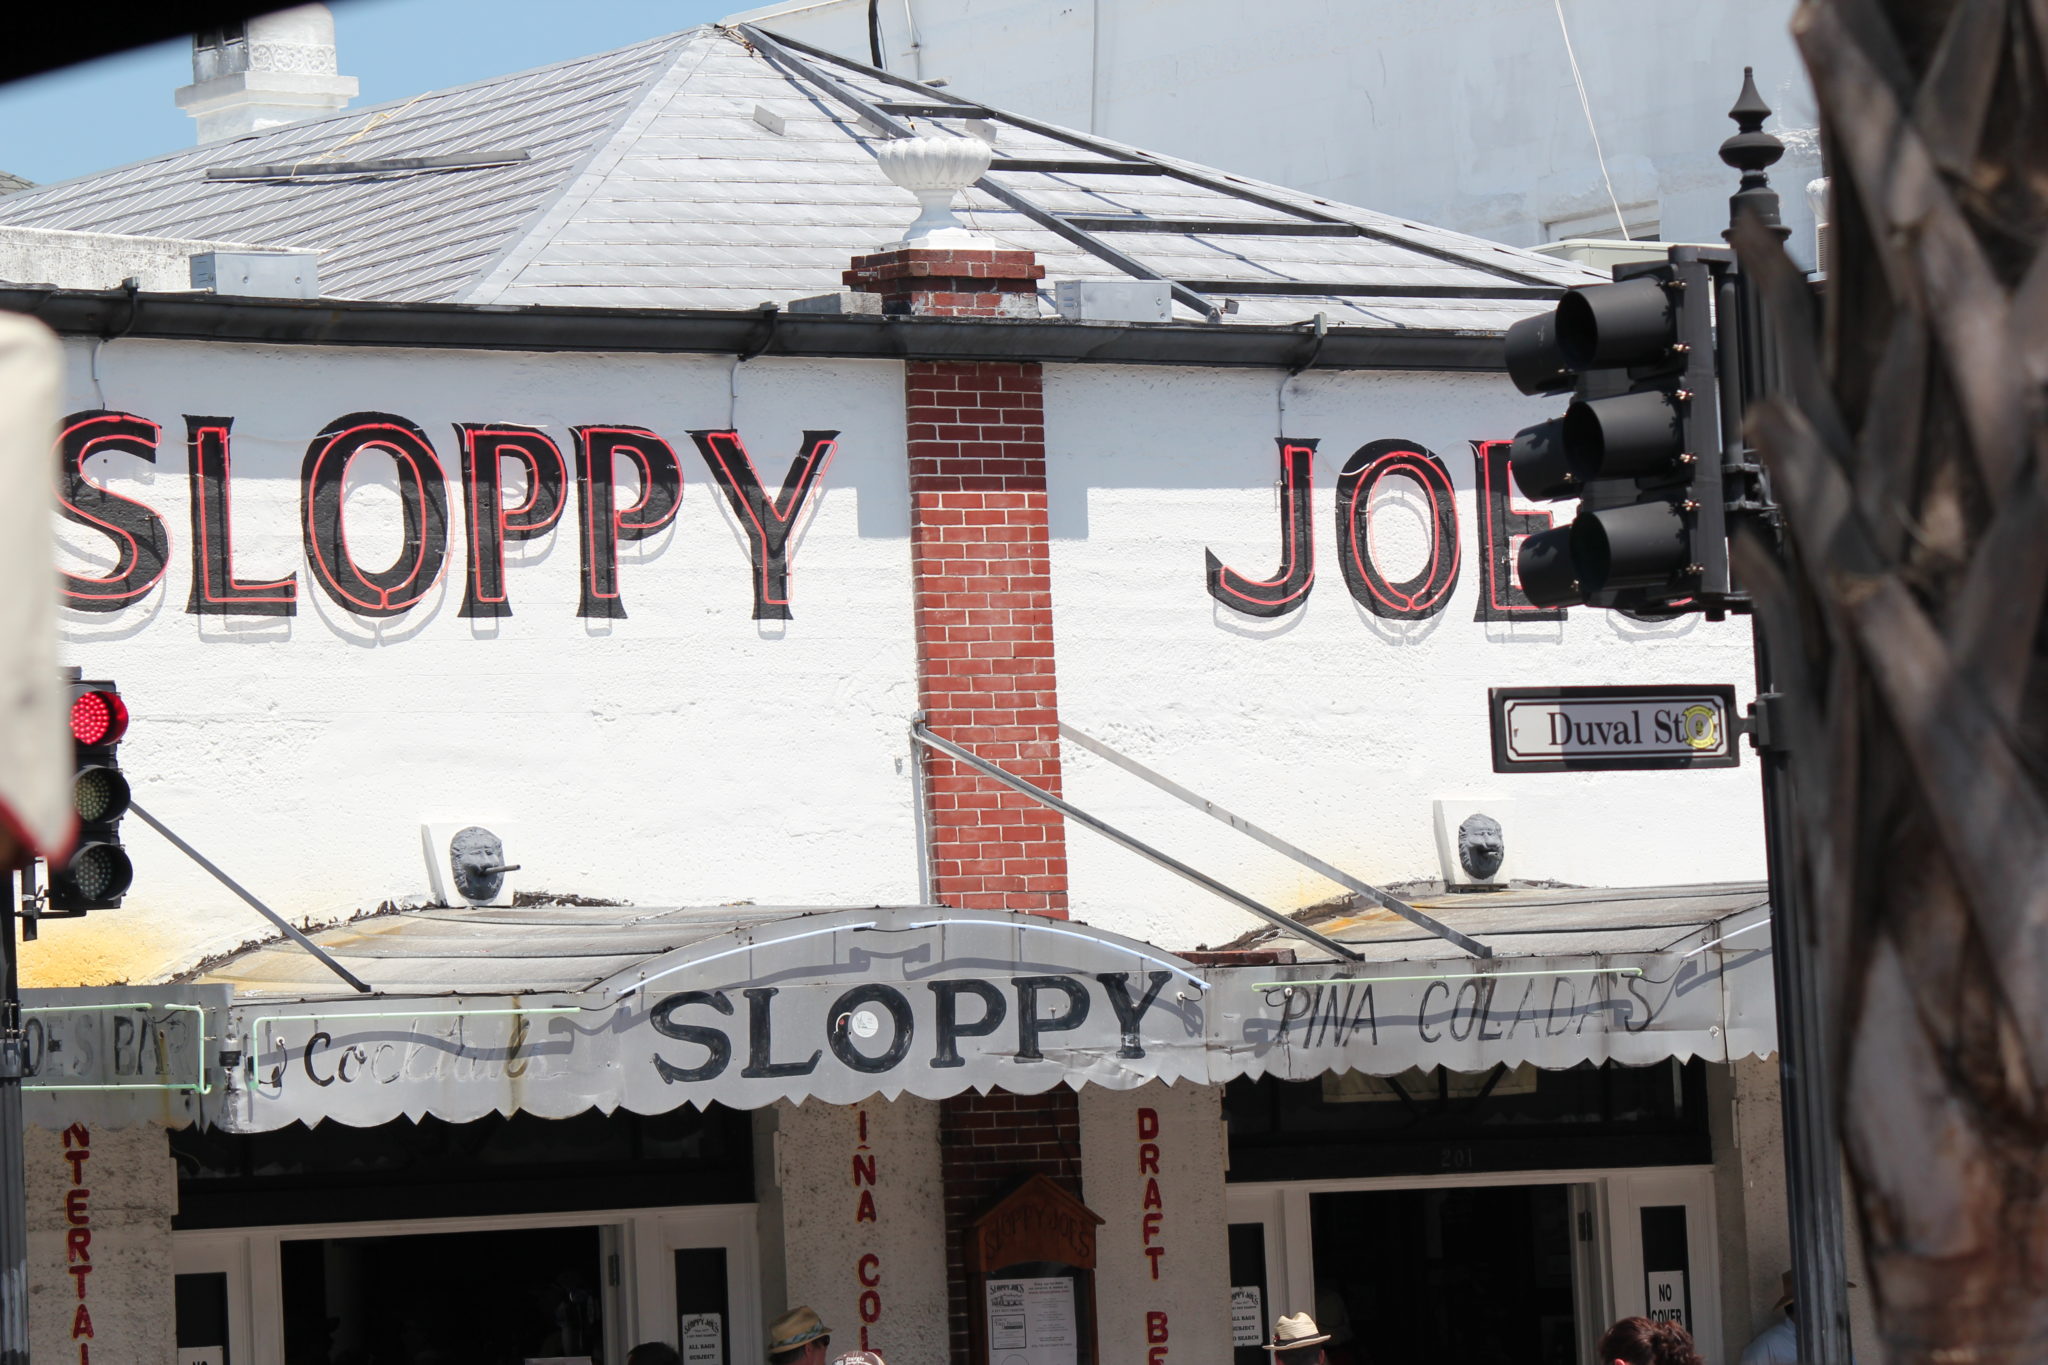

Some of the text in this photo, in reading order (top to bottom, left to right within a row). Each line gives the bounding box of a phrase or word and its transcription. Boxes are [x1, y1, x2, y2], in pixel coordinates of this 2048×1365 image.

[57, 411, 839, 621] SLOPPY
[1205, 438, 1702, 622] JOE
[1547, 709, 1686, 746] Duval St
[113, 1014, 192, 1077] BAR
[650, 970, 1172, 1084] SLOPPY
[1137, 1107, 1165, 1281] DRAFT
[1440, 1148, 1473, 1168] 201
[850, 1103, 882, 1356] IÑA COL
[1658, 1283, 1672, 1302] NO
